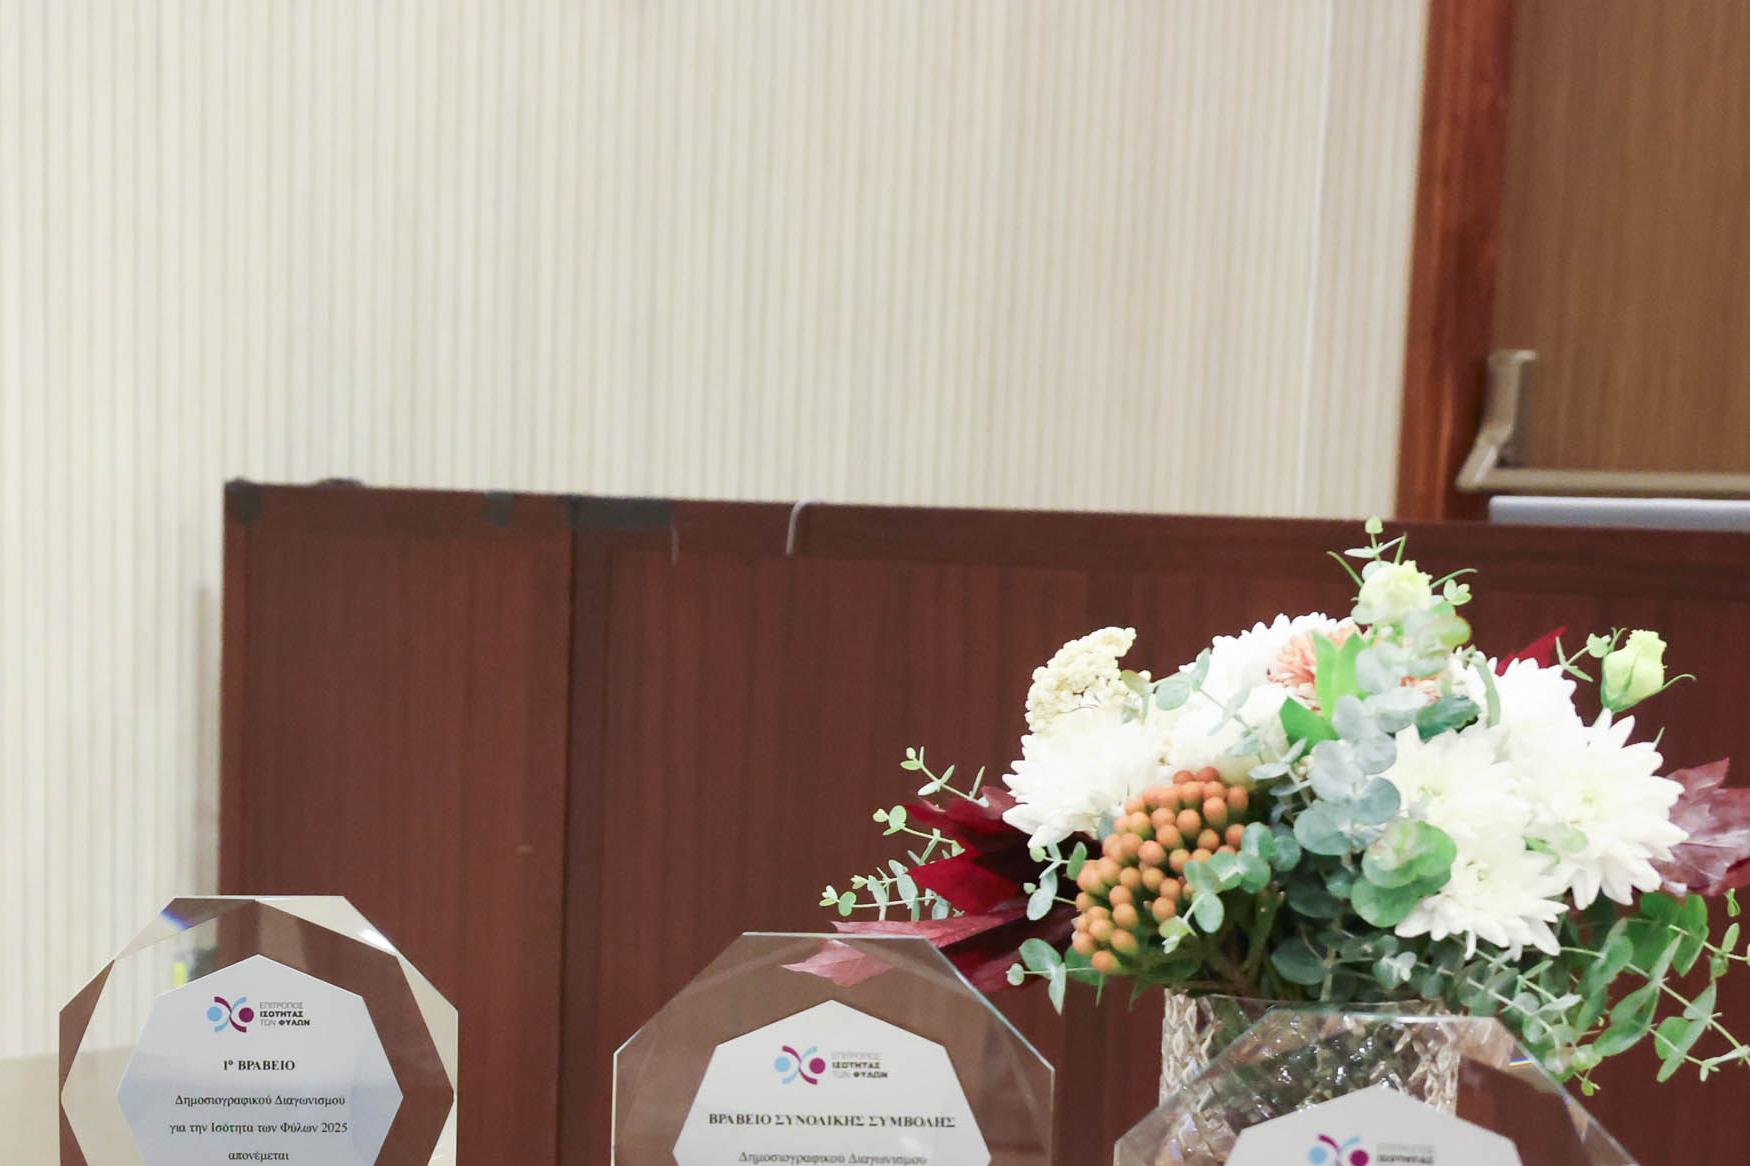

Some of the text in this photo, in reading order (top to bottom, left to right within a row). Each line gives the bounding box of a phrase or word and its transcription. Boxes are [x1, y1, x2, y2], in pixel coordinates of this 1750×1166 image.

[238, 1060, 296, 1071] ΒΡΑΒΕΙΟ
[175, 1094, 346, 1108] Δημοσιογραφικού Διαγωνισμού
[169, 1121, 348, 1135] για την Ισότητα των Φύλων 2025
[227, 1151, 289, 1163] απονέμεται
